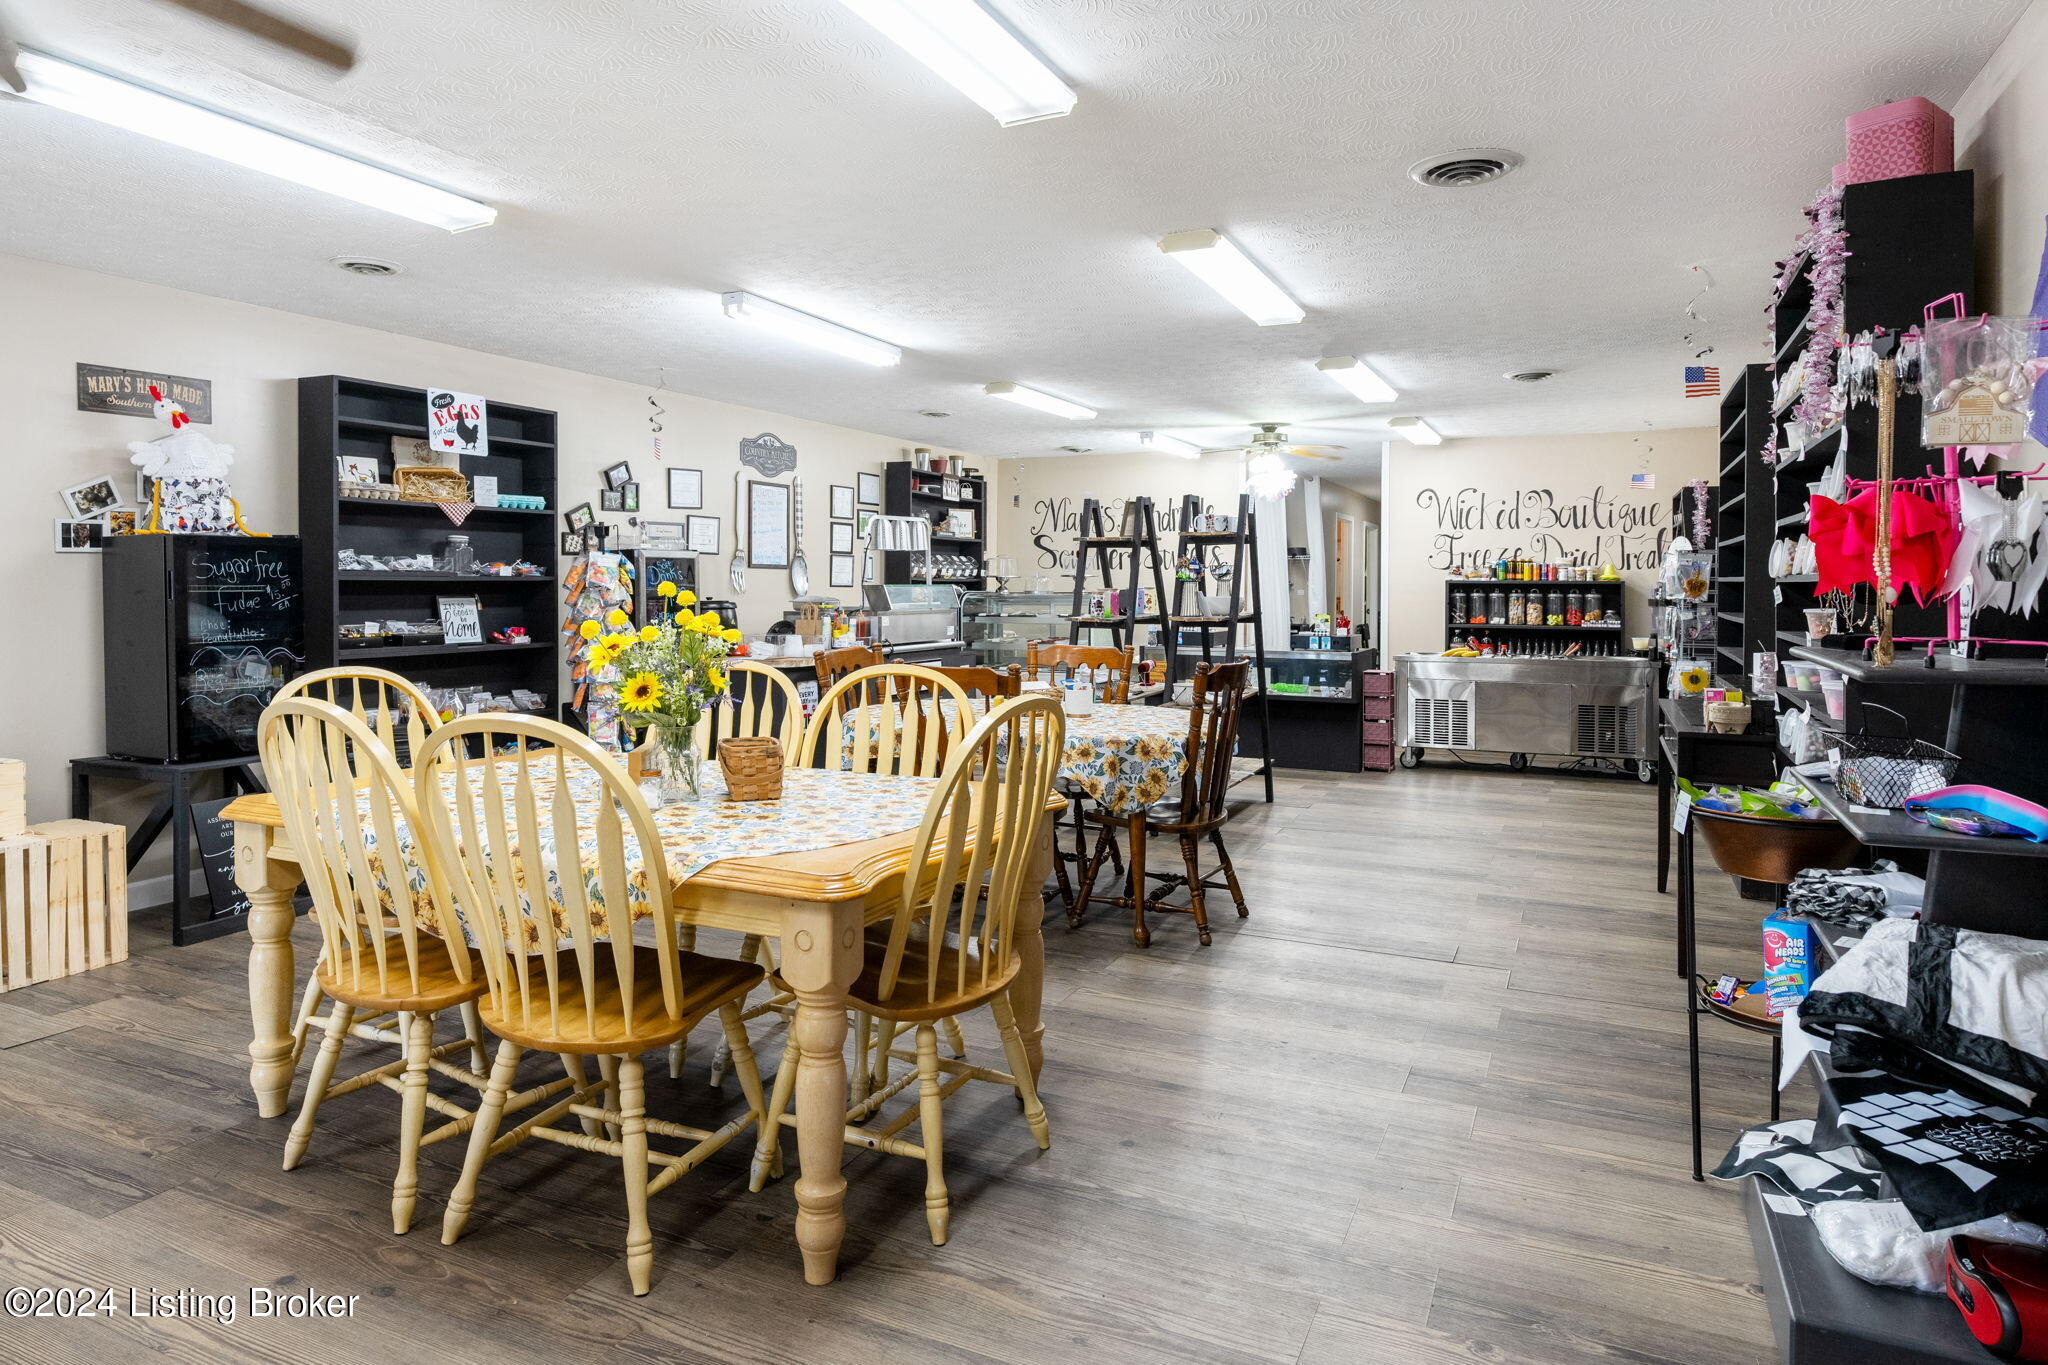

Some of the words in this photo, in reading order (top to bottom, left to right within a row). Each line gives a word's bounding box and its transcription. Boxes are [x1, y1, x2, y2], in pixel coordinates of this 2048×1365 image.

[87, 376, 132, 394] MARY'S
[172, 384, 204, 406] MADE
[106, 394, 153, 410] Southern
[434, 394, 452, 408] Fresh
[433, 403, 480, 427] EGGS
[1941, 416, 1977, 424] SMALL
[443, 426, 456, 435] Sale
[1030, 497, 1115, 536] Ma's
[1416, 487, 1520, 530] Wicked
[1523, 485, 1672, 534] Boutique
[1604, 526, 1674, 571] Treat
[191, 551, 253, 584] Sugar
[221, 822, 234, 830] ARE
[220, 830, 234, 838] OUR
[1786, 937, 1805, 948] AIR
[1774, 947, 1805, 958] HEADS
